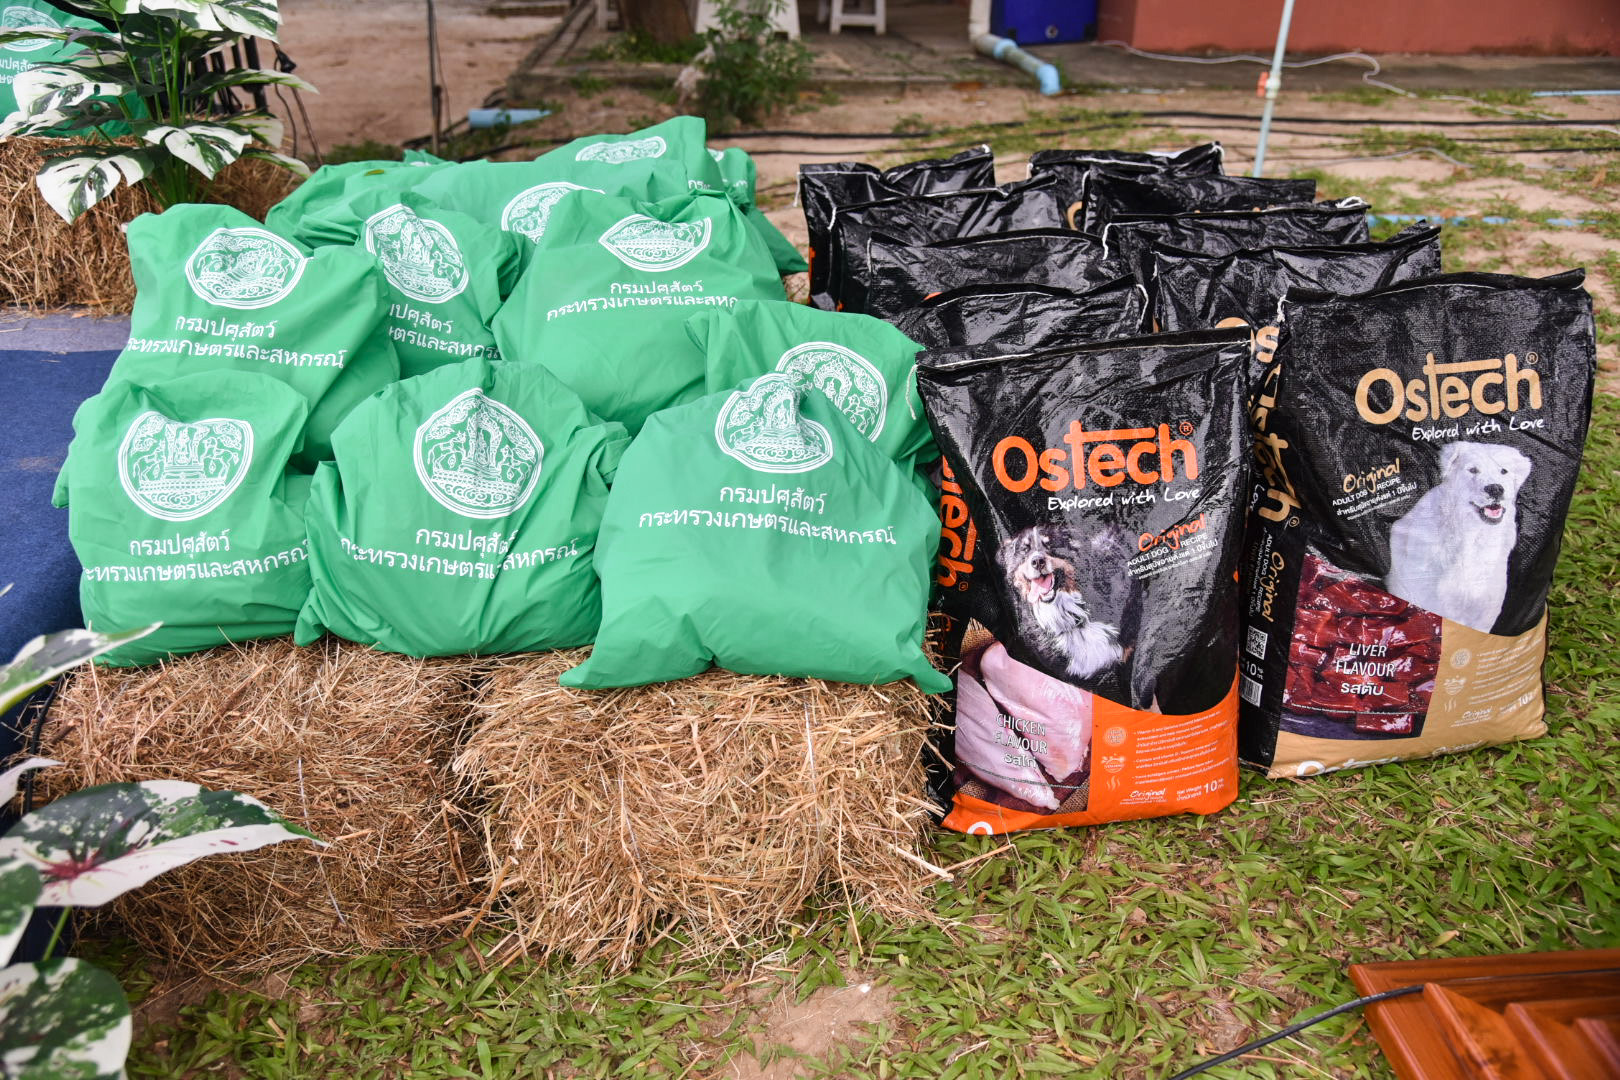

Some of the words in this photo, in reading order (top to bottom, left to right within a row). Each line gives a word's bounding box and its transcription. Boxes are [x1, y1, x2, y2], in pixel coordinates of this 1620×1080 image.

[175, 315, 278, 342] กรมปศุสัตว์
[1354, 351, 1542, 425] Ostech
[1411, 424, 1460, 441] Explored
[1466, 418, 1502, 435] with
[1509, 417, 1545, 431] Love
[992, 419, 1199, 493] Ostech
[1342, 457, 1400, 494] Original
[719, 483, 827, 515] กรมปศุสัตว์
[1047, 493, 1113, 511] Explored
[1121, 491, 1156, 505] with
[1164, 486, 1200, 502] Love
[1332, 494, 1355, 507] ADULT
[1355, 489, 1368, 500] DOG
[1376, 477, 1401, 491] RECIPE
[638, 509, 897, 545] กระทรวงเกษตรและสหกรณ์
[1137, 513, 1206, 551] Original
[129, 529, 231, 559] กรมปศุสัตว์
[1127, 553, 1151, 567] ADULT
[1151, 546, 1169, 558] DOG
[1180, 532, 1208, 548] RECIPE
[1261, 558, 1270, 577] DOG
[1260, 551, 1285, 623] Original
[1349, 642, 1387, 658] LIVER
[1246, 660, 1257, 676] 10
[1335, 660, 1396, 678] FLAVOUR
[1340, 681, 1384, 696] รสตับ
[996, 713, 1046, 737] CHICKEN
[995, 730, 1048, 755] FLAVOUR
[1129, 788, 1166, 799] Original
[1203, 780, 1218, 794] 10
